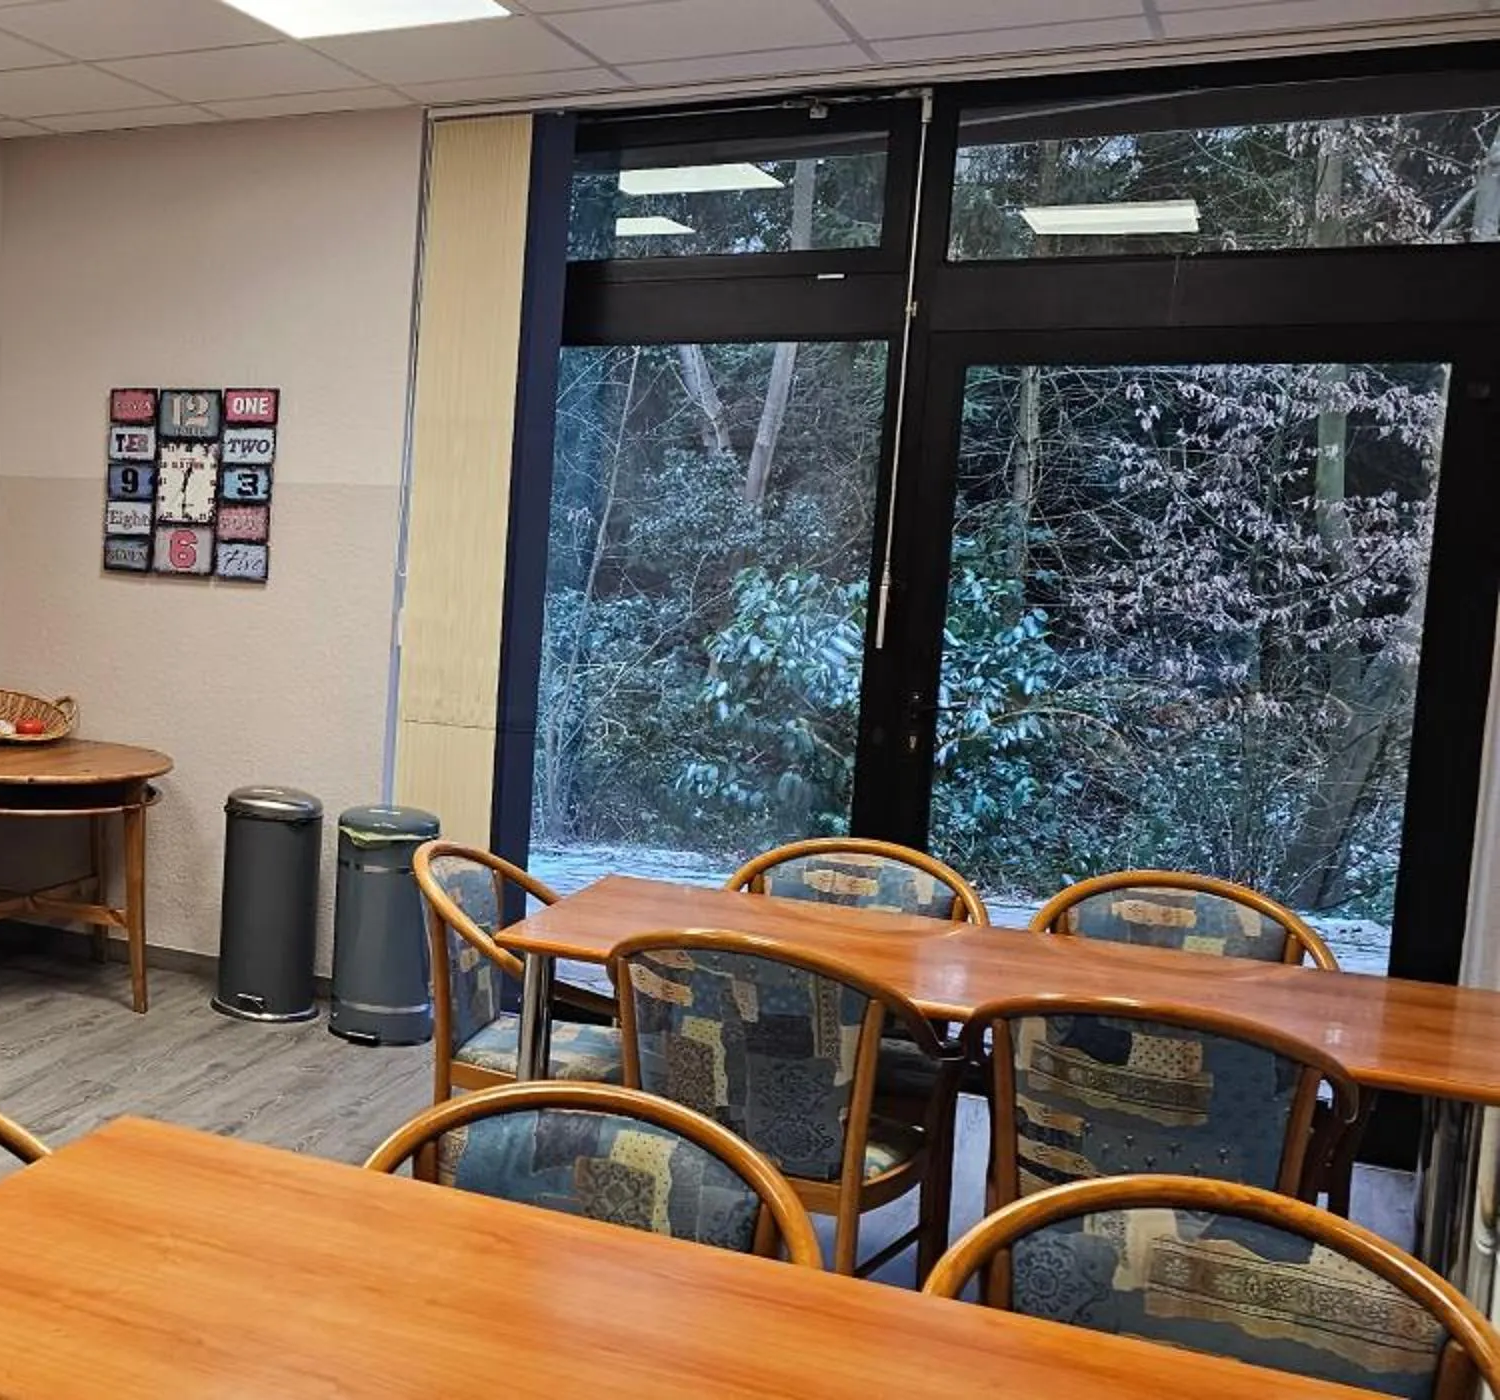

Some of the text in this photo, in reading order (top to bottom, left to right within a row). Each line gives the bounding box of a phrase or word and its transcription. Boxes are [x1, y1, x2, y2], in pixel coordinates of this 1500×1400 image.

[172, 393, 209, 427] 12
[232, 397, 269, 415] ONE
[227, 438, 270, 454] TWO
[121, 467, 139, 493] 9
[237, 473, 259, 496] 3
[169, 529, 198, 569] 6
